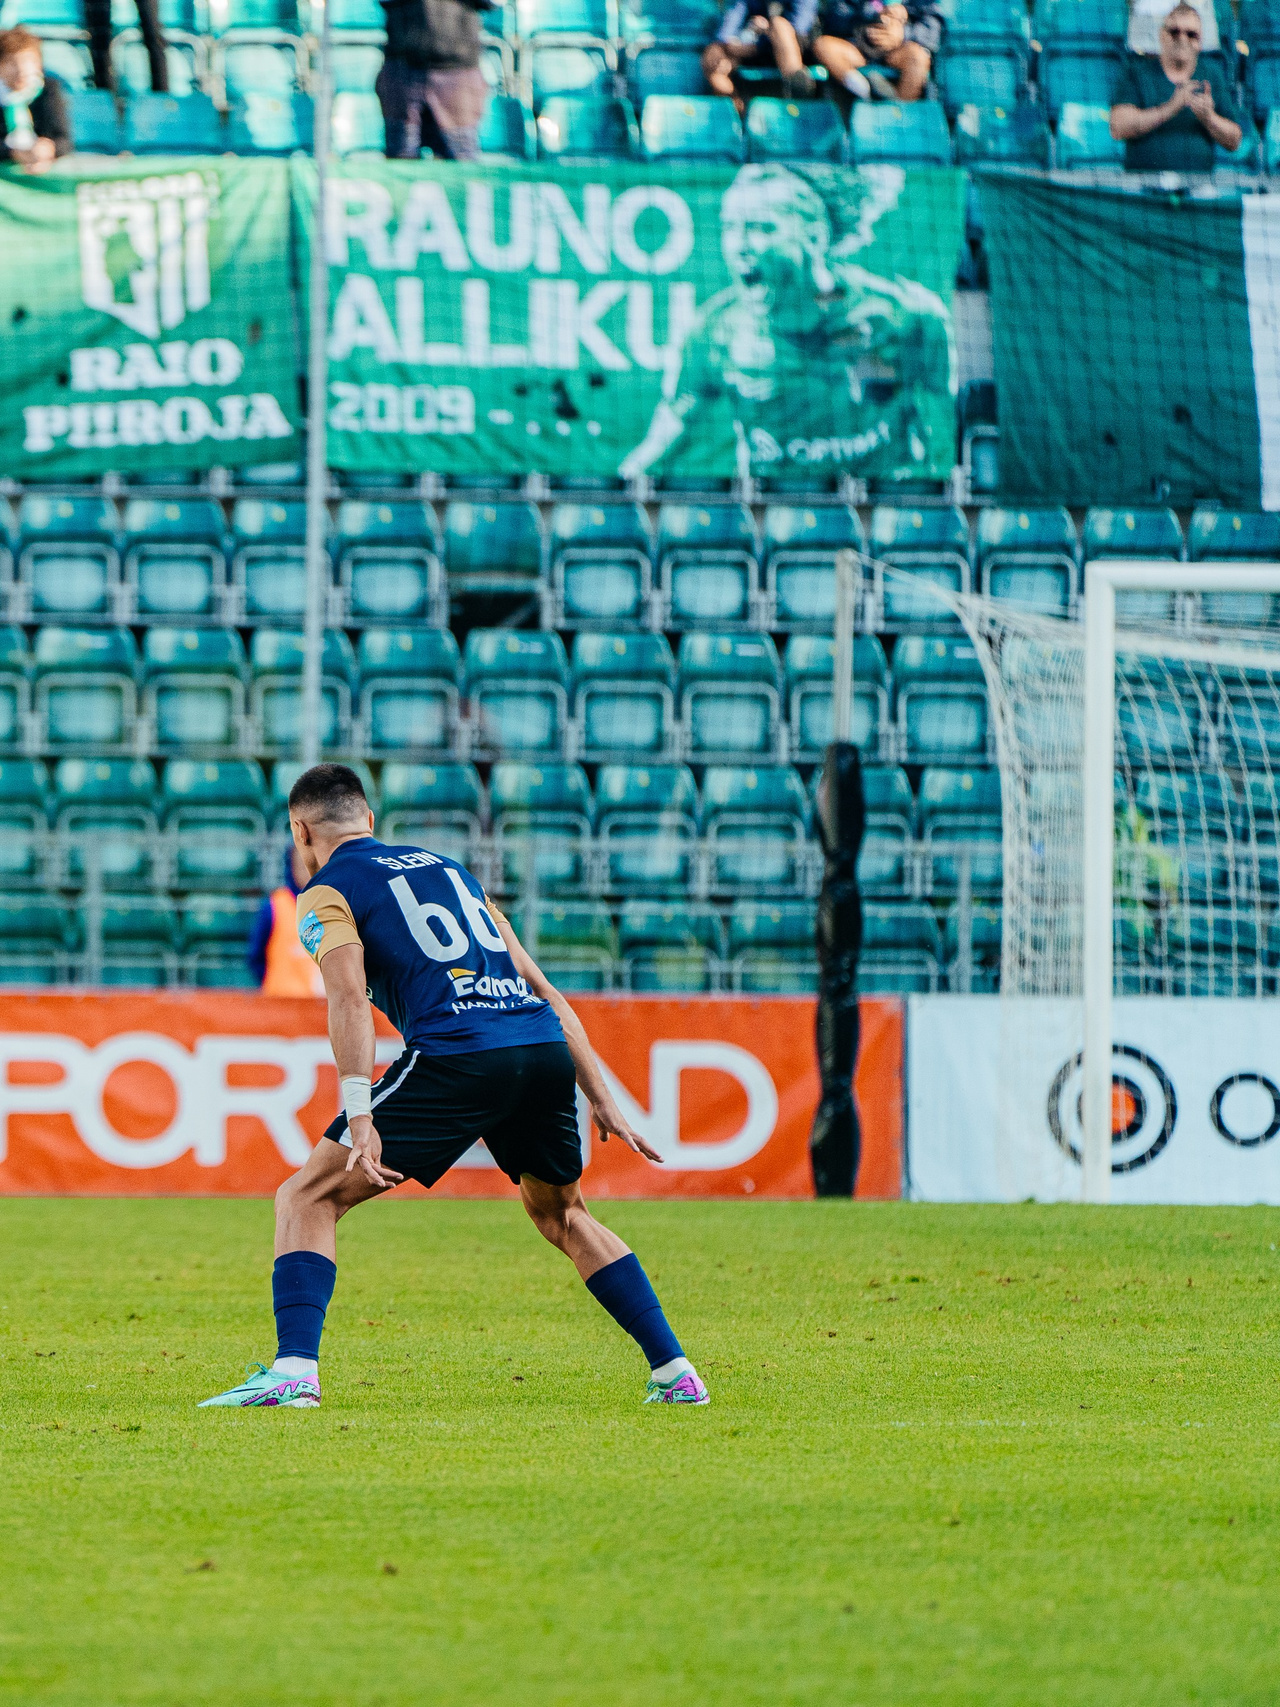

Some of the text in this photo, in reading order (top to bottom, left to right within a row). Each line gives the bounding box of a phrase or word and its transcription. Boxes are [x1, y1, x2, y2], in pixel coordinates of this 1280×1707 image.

[322, 177, 696, 275] RAUNO
[324, 273, 697, 372] ALLIKU
[70, 338, 245, 392] RAIO
[22, 393, 295, 453] PIIROJA
[328, 381, 476, 435] 2009
[388, 867, 508, 963] 66
